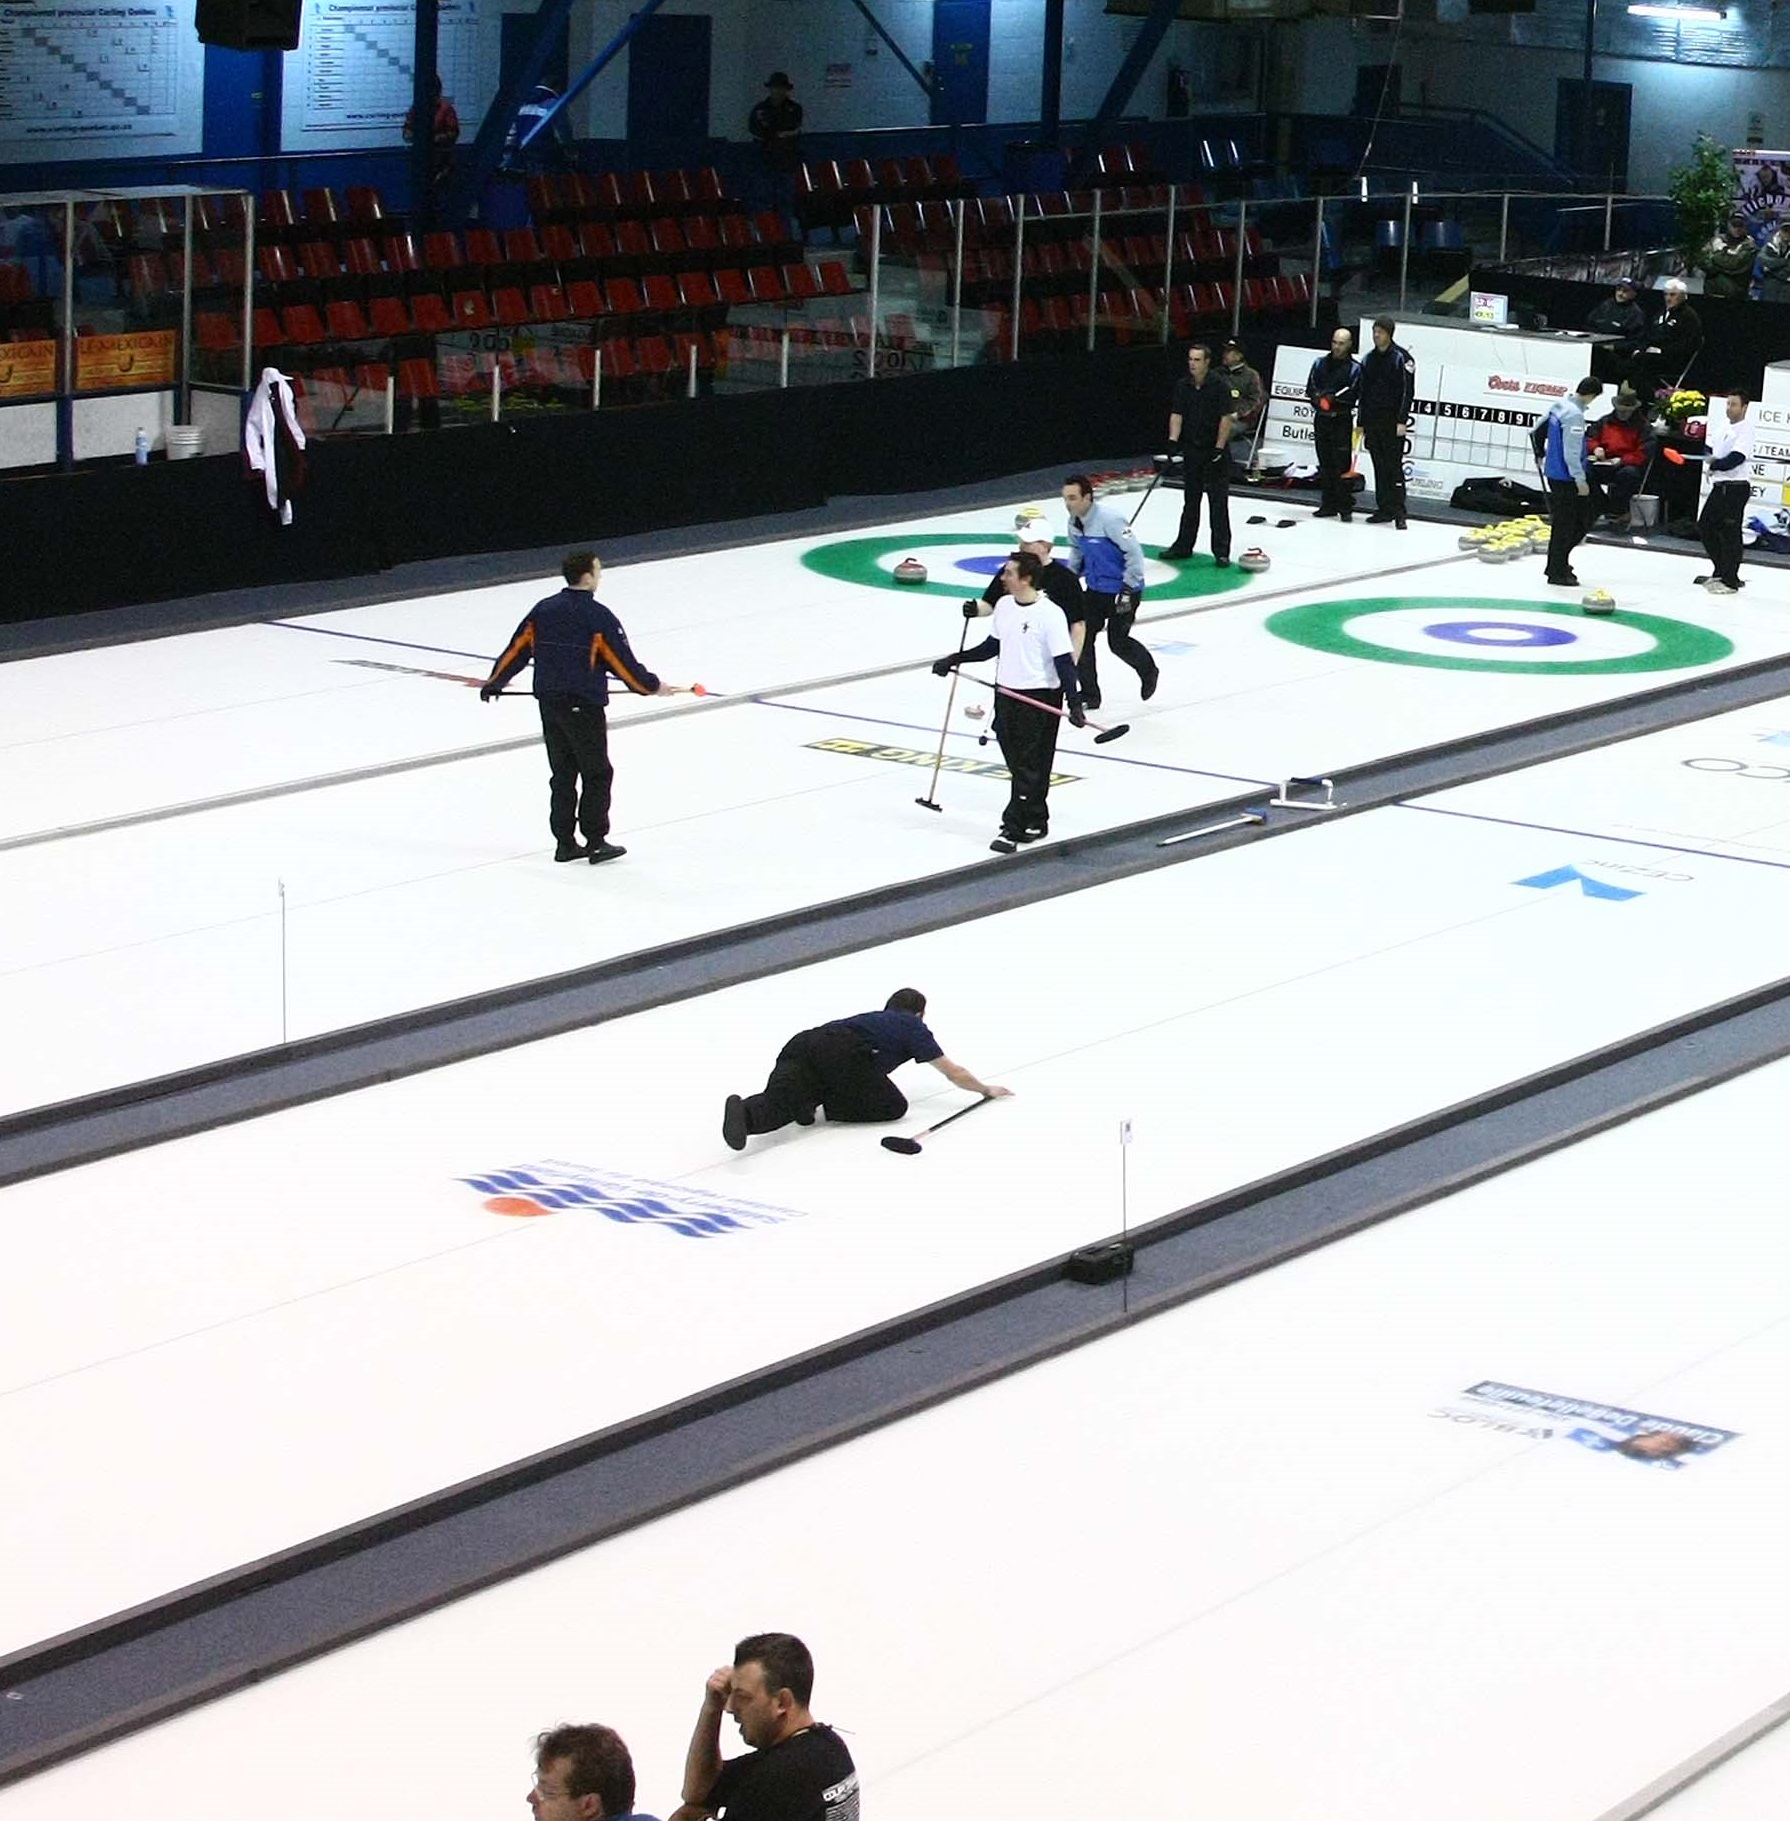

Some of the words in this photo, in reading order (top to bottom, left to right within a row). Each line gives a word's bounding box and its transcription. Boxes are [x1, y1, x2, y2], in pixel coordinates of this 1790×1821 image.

[1424, 403, 1432, 414] 4
[1444, 403, 1452, 415] 5
[1461, 406, 1470, 418] 6
[1480, 408, 1489, 420] 7
[1497, 410, 1506, 422] 8
[1515, 413, 1524, 425] 9
[1758, 410, 1782, 423] ICE
